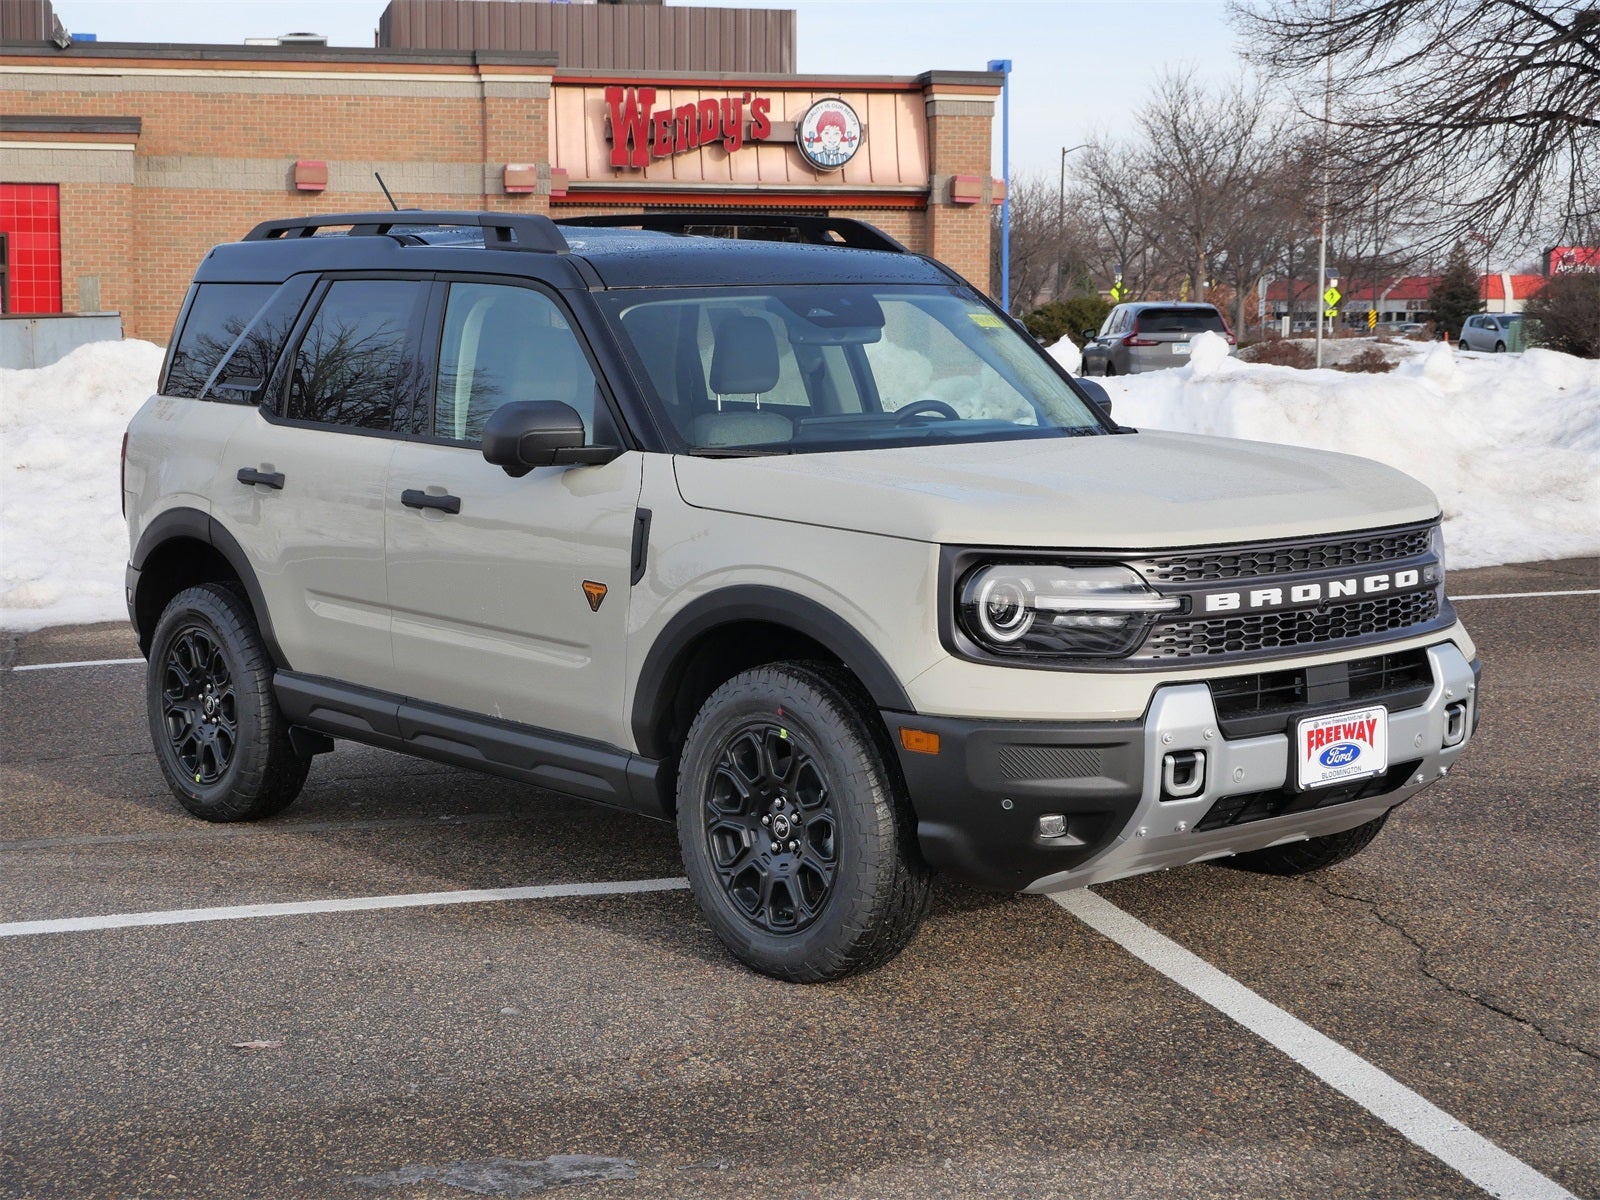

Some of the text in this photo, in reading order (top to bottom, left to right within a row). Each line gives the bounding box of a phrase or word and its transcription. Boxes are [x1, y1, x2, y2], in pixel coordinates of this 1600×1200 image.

[806, 105, 823, 124] QUALITY
[843, 108, 857, 126] RECIPE
[1205, 569, 1419, 611] BRONCO
[1307, 717, 1377, 762] FREEWAY
[1326, 746, 1353, 765] Ford
[1321, 765, 1362, 779] BLOOMINGTON
